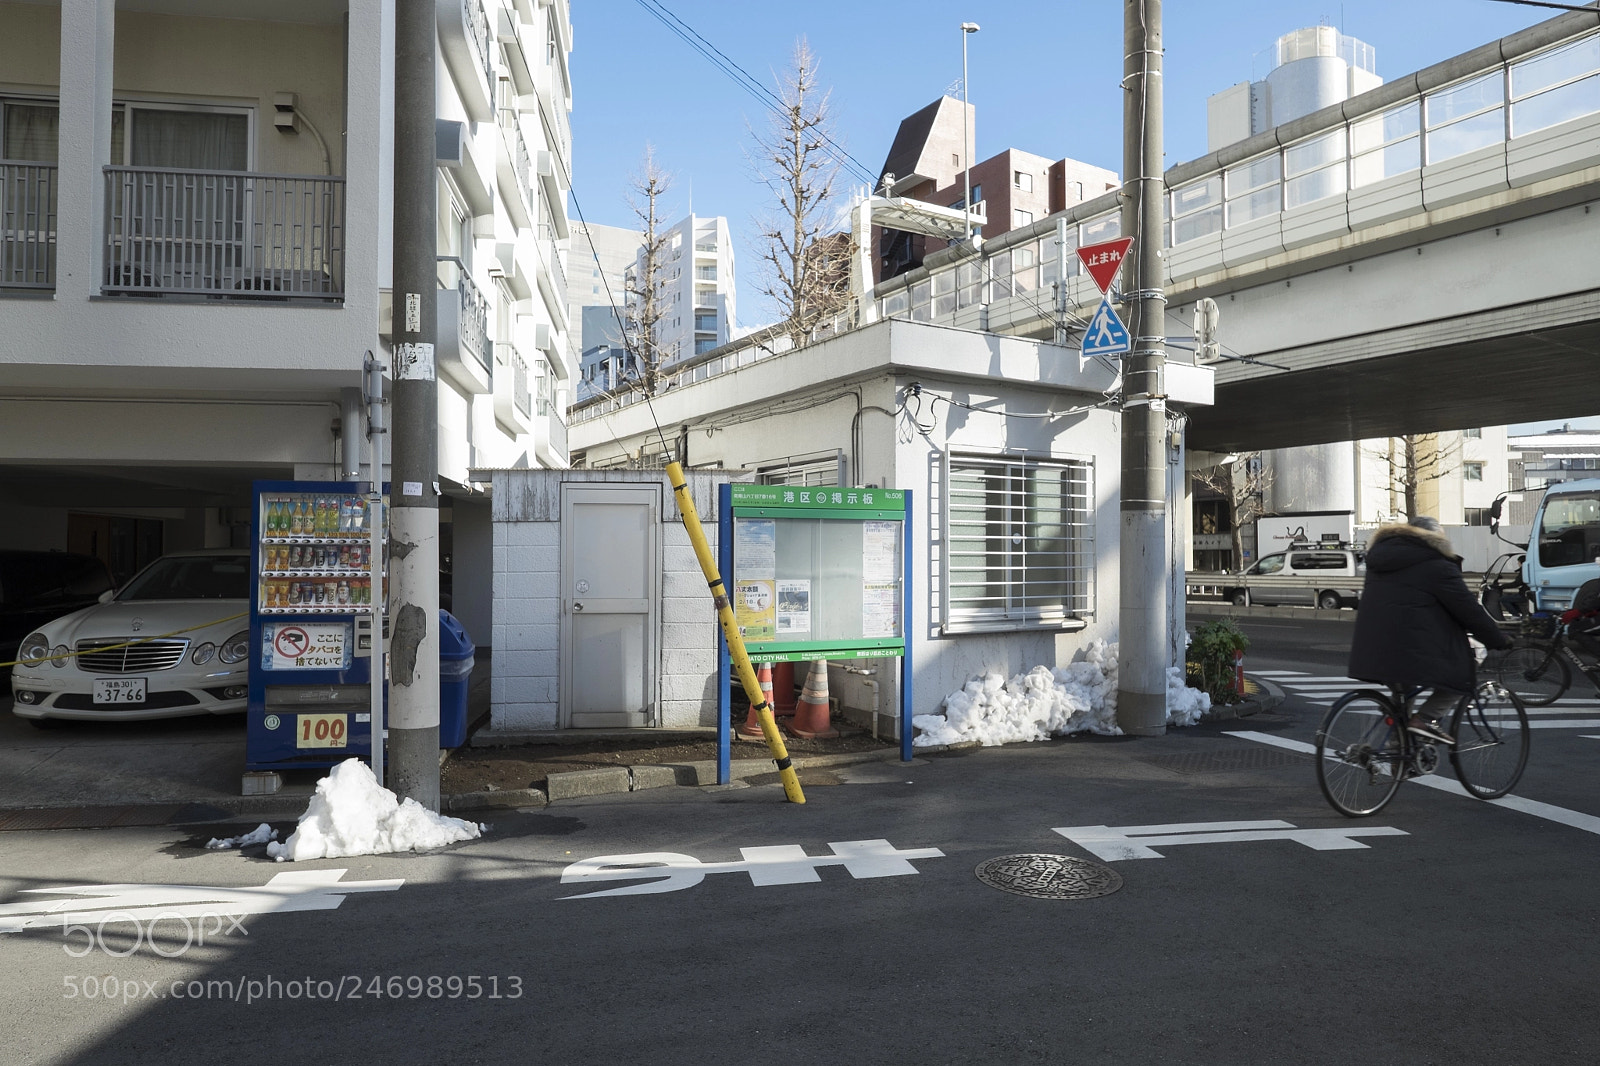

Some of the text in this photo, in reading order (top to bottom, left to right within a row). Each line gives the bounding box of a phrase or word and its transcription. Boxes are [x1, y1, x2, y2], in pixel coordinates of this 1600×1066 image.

[1088, 250, 1121, 266] 止まれ
[783, 490, 811, 503] 港区
[831, 492, 873, 505] 掲示板
[317, 633, 343, 643] ここに
[307, 645, 342, 655] タバコを
[295, 657, 342, 667] 捨てないで
[105, 689, 142, 702] 37-66
[302, 718, 345, 741] 100
